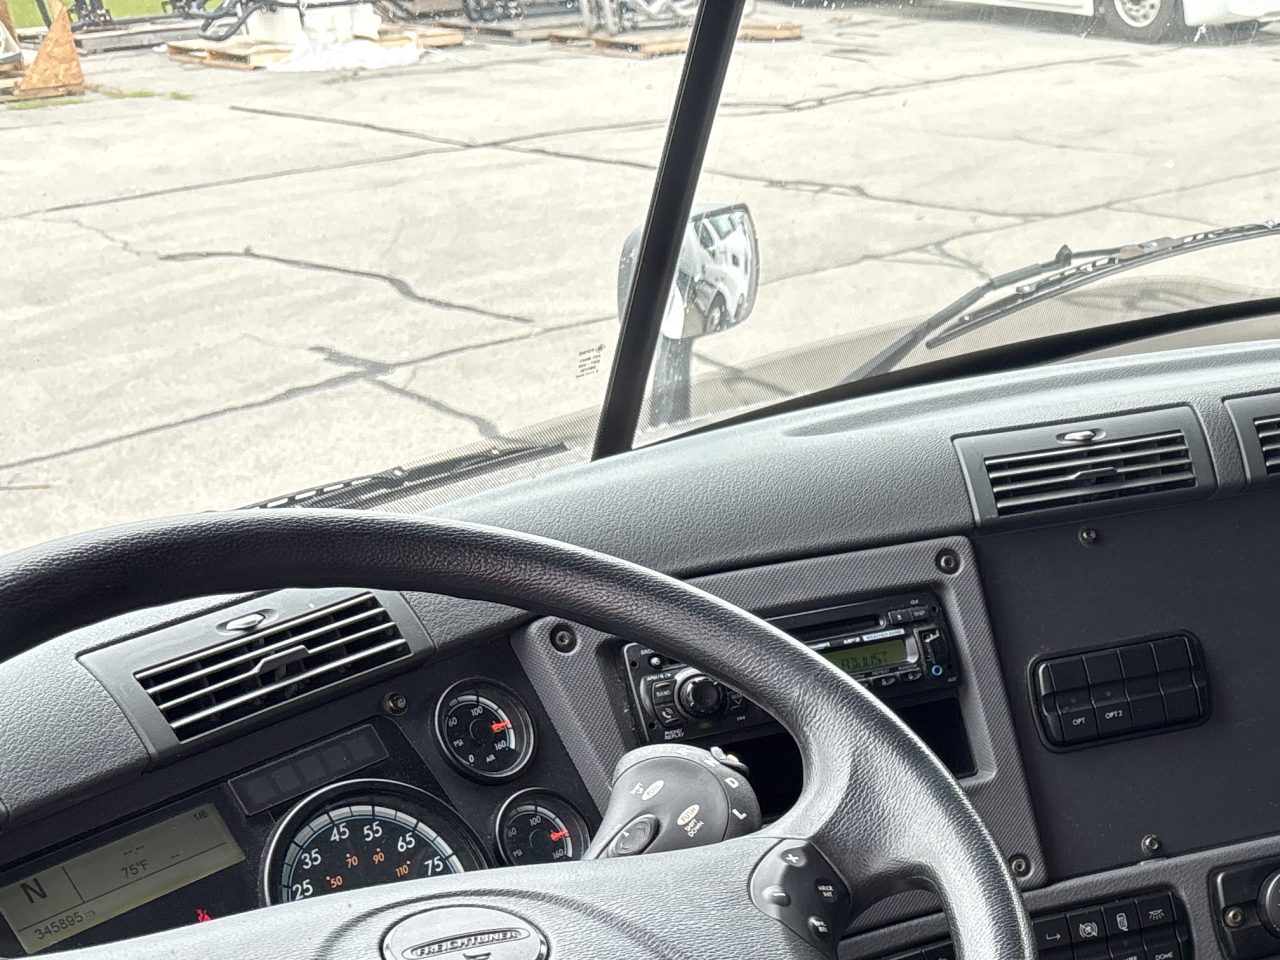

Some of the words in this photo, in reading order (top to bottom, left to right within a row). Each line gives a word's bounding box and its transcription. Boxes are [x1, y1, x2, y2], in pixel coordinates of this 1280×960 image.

[470, 706, 483, 716] 100
[1104, 710, 1118, 719] OPT
[1072, 717, 1085, 726] OPT
[453, 739, 464, 748] PSI
[494, 740, 507, 751] 160
[468, 754, 475, 763] 0
[725, 777, 739, 788] D
[681, 807, 696, 822] PUSH
[732, 808, 747, 820] L
[529, 816, 542, 827] 100
[330, 822, 350, 842] 45
[363, 821, 383, 841] 55
[507, 827, 517, 837] 60
[687, 820, 704, 838] DOWN
[397, 832, 416, 852] 65
[301, 848, 322, 869] 35
[345, 855, 359, 869] 70
[372, 852, 385, 864] 90
[395, 865, 409, 877] 110
[424, 855, 444, 876] 75
[330, 876, 343, 888] 50
[20, 878, 48, 904] N
[292, 879, 314, 900] 25
[34, 911, 84, 940] 345895
[1155, 952, 1174, 960] DOME
